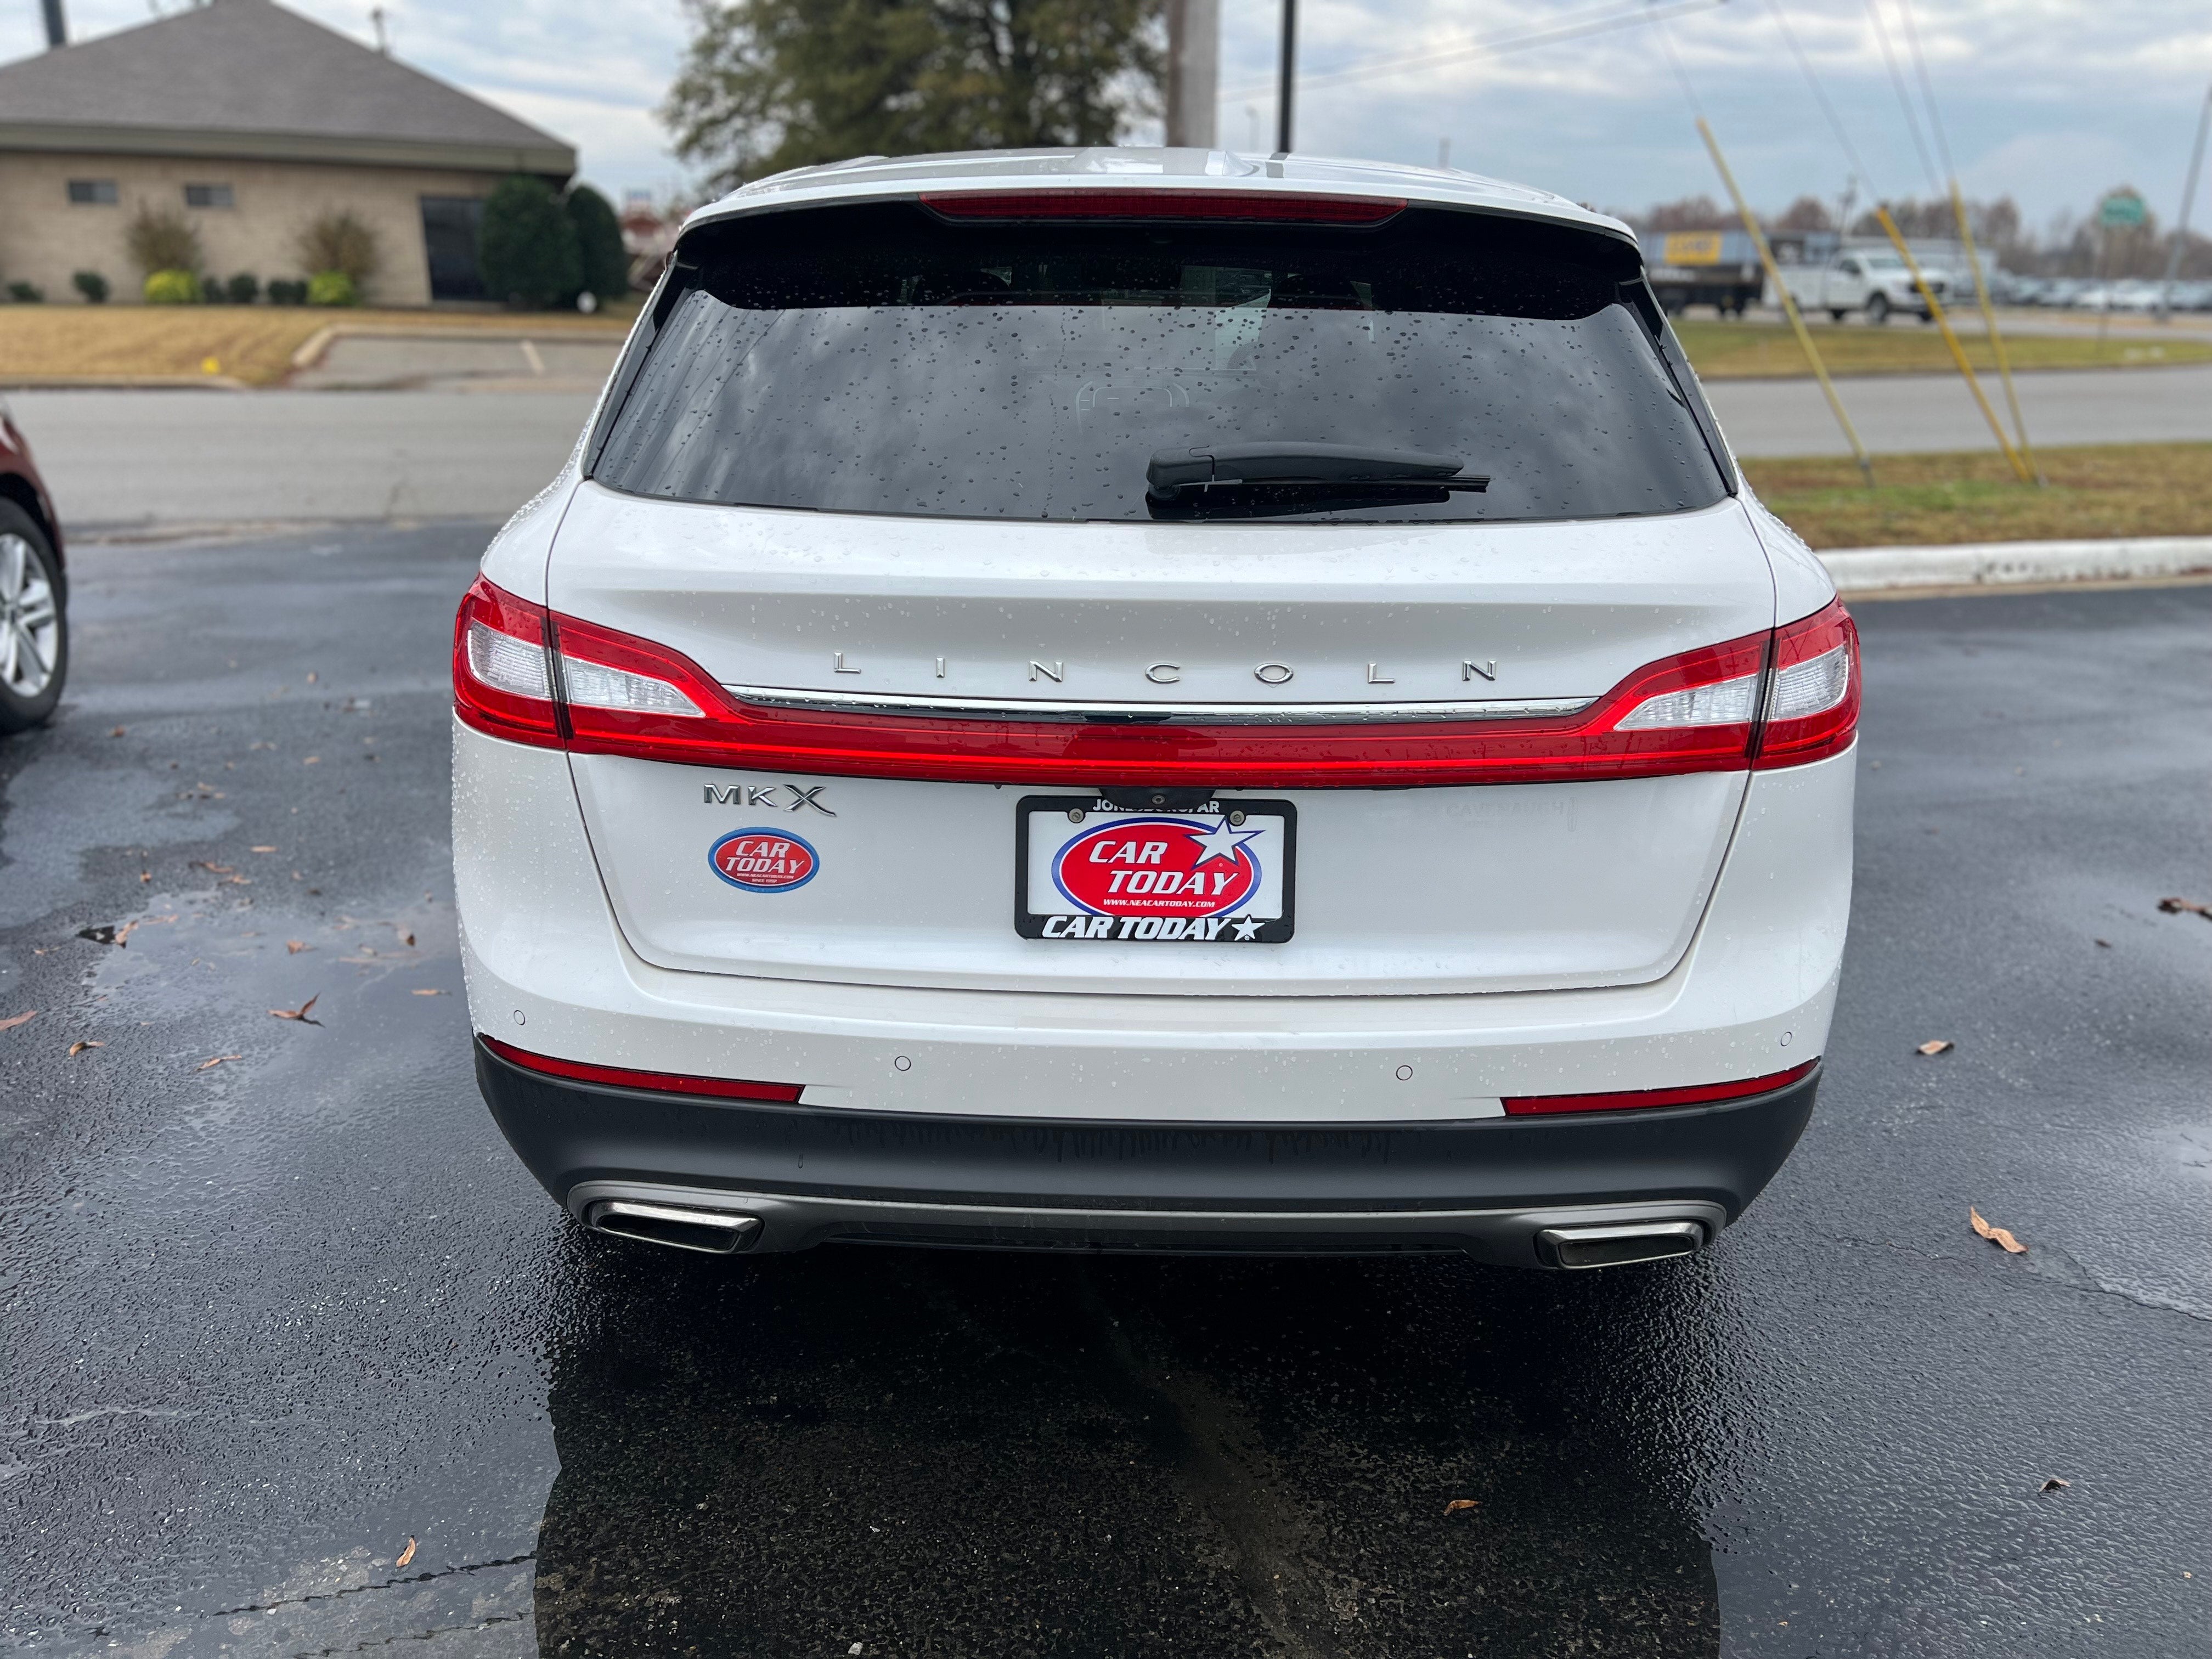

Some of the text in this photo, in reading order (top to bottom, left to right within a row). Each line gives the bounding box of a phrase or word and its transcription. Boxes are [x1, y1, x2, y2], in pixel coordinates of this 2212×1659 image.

[834, 652, 1497, 685] LINCOLN
[703, 783, 837, 817] MKX
[1197, 801, 1220, 813] AR
[735, 840, 791, 857] CAR
[1088, 840, 1169, 865] CAR
[725, 857, 805, 874] TODAY
[1107, 870, 1240, 896] TODAY
[1103, 899, 1215, 908] WWW.NEACARTODAY.COM
[1042, 915, 1232, 941] CAR TODAY
